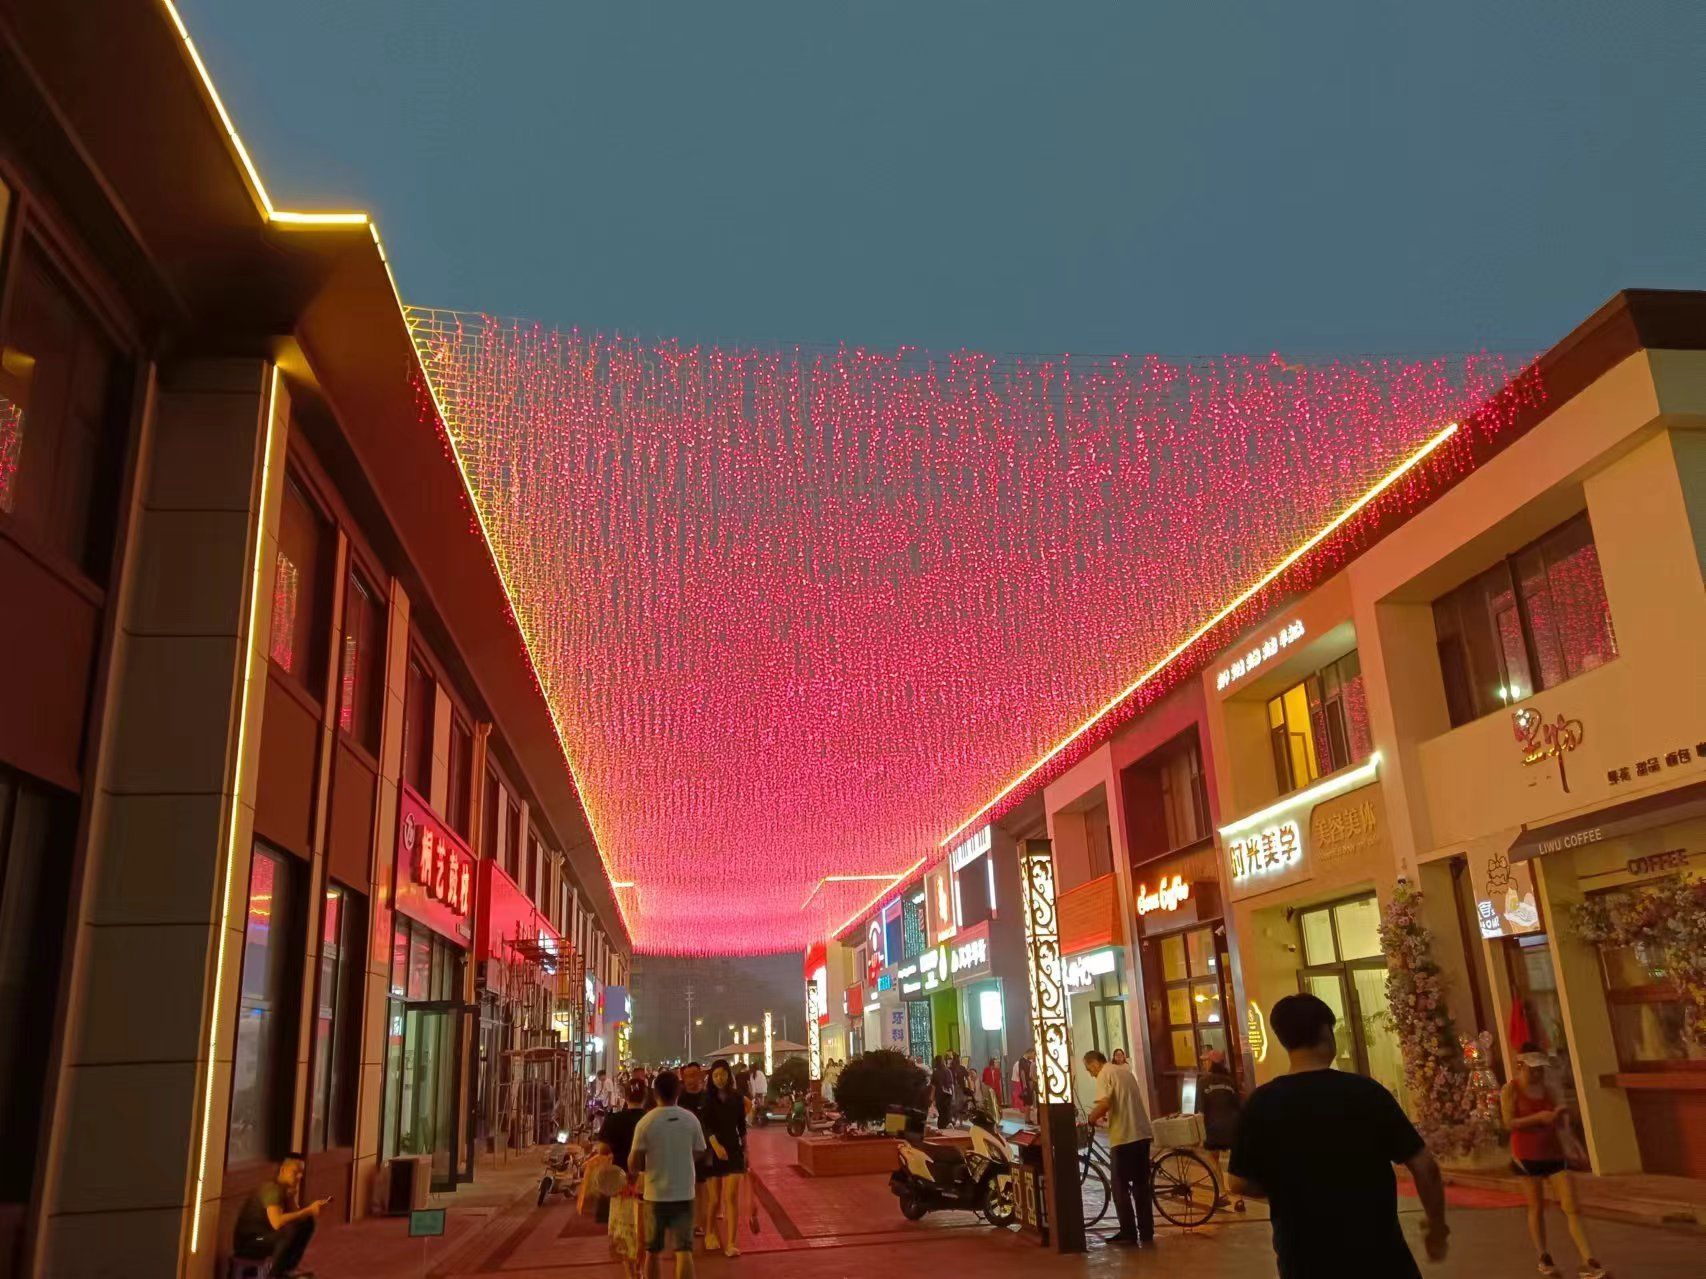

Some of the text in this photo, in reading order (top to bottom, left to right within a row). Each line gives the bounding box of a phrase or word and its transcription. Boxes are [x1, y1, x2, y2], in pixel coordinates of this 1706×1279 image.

[1316, 802, 1376, 847] 美容美体
[1538, 828, 1603, 855] LIWU COFFEE
[1230, 824, 1298, 878] 时光美学
[892, 1011, 905, 1041] 牙科
